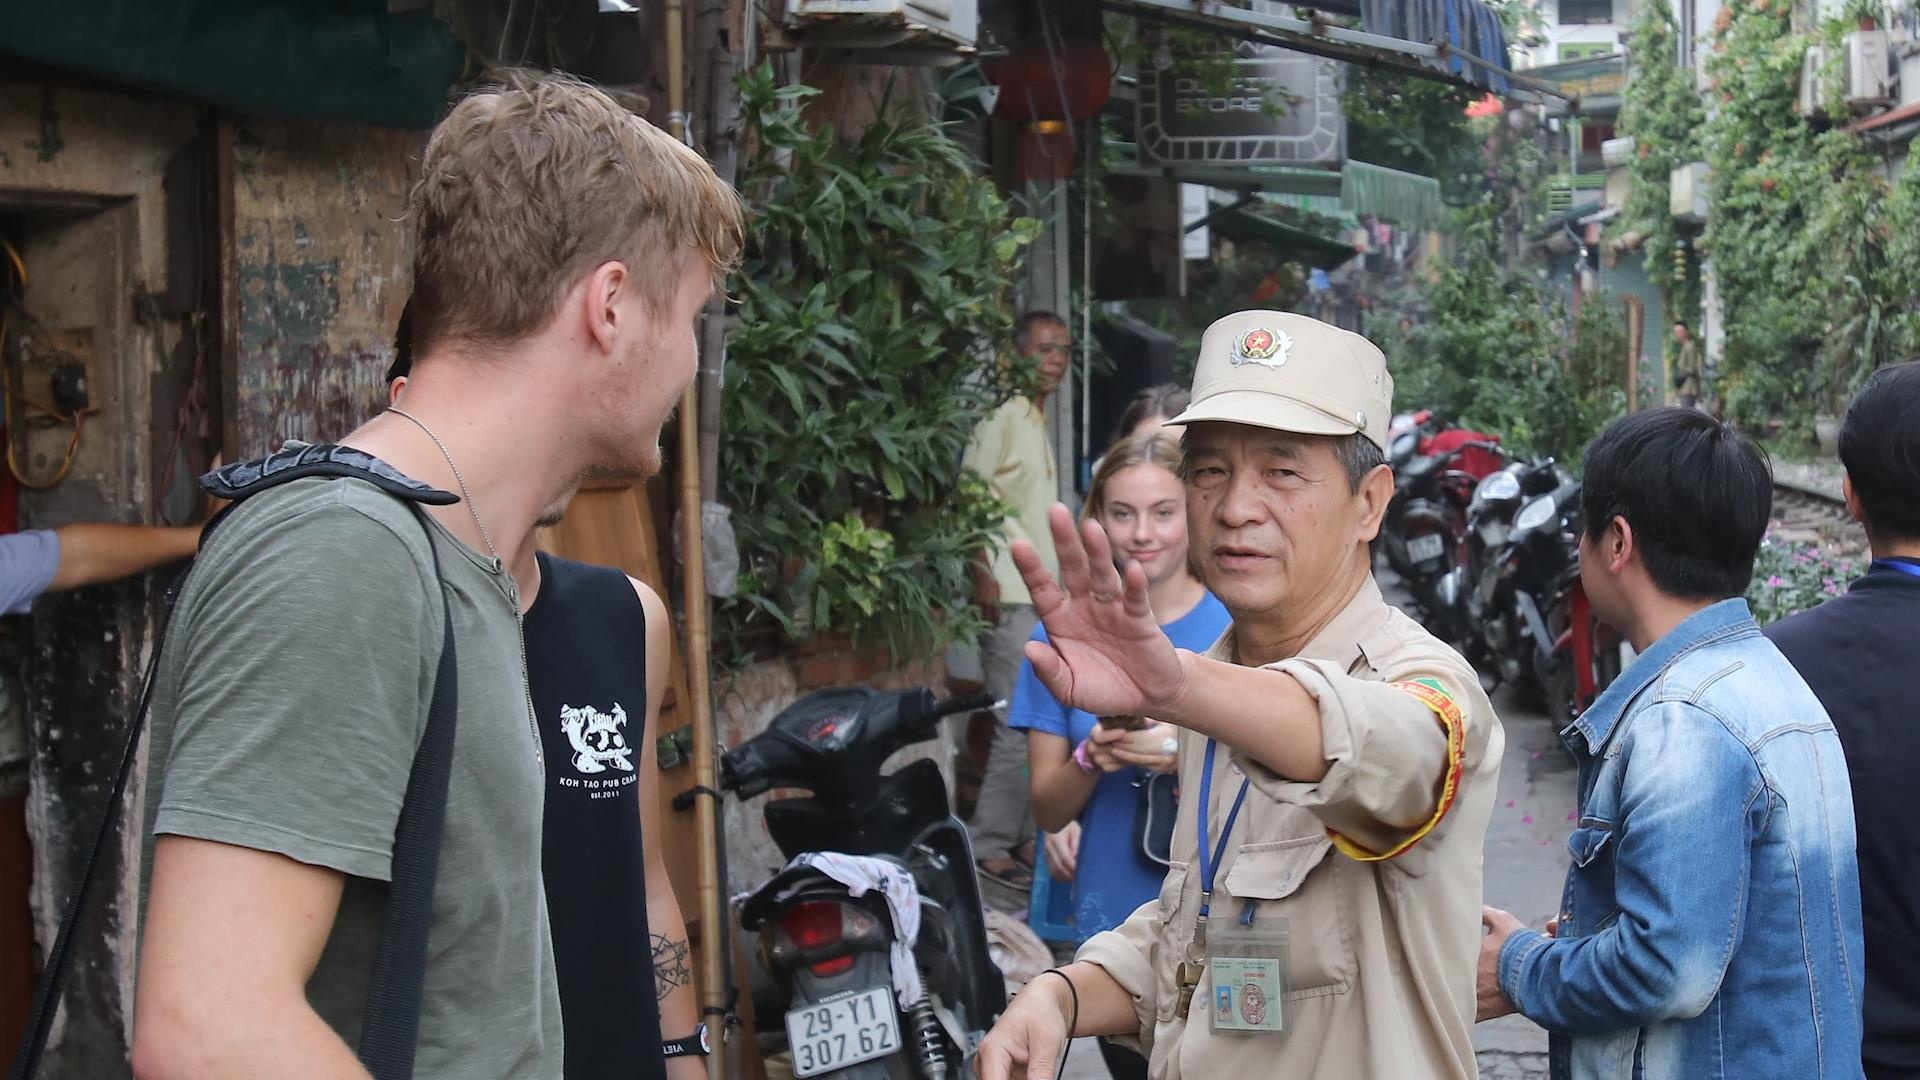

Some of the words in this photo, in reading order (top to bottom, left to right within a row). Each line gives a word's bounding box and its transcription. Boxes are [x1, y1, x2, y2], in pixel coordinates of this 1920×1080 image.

[560, 777, 579, 787] KOH
[583, 780, 600, 789] TAO
[603, 779, 620, 788] PUB
[803, 996, 876, 1038] 29-Y1
[800, 1023, 892, 1070] 307.62
